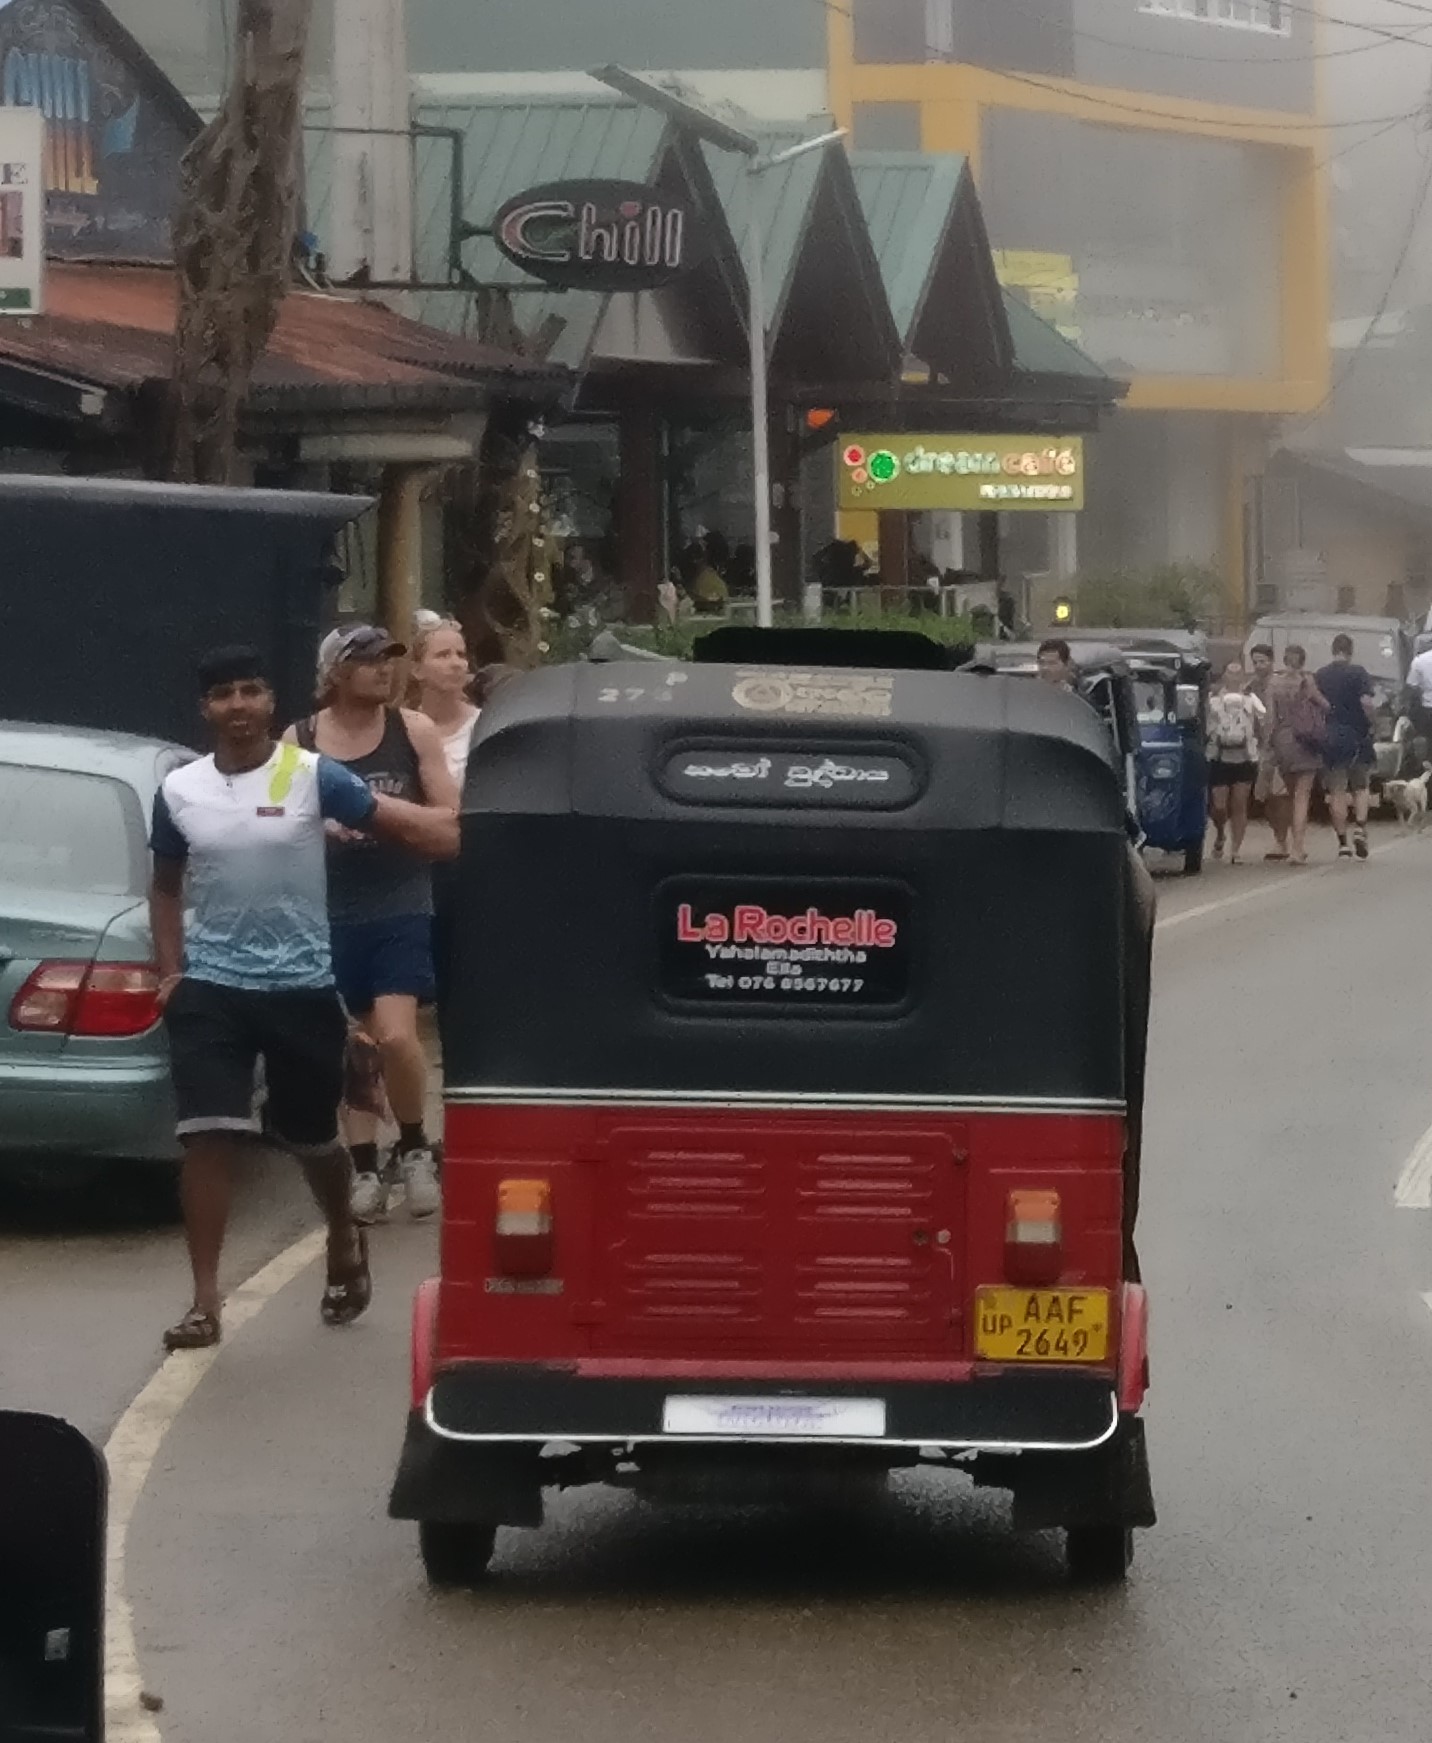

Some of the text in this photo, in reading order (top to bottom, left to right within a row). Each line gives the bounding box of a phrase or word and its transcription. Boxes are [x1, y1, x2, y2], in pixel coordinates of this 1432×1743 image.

[502, 201, 684, 267] Chill
[677, 904, 897, 947] La Rochelle
[705, 974, 734, 989] Tel
[738, 976, 775, 989] 076
[766, 961, 802, 975] Ella
[1023, 1293, 1087, 1324] AAF
[982, 1314, 1012, 1334] UP
[1015, 1328, 1088, 1356] 2649
